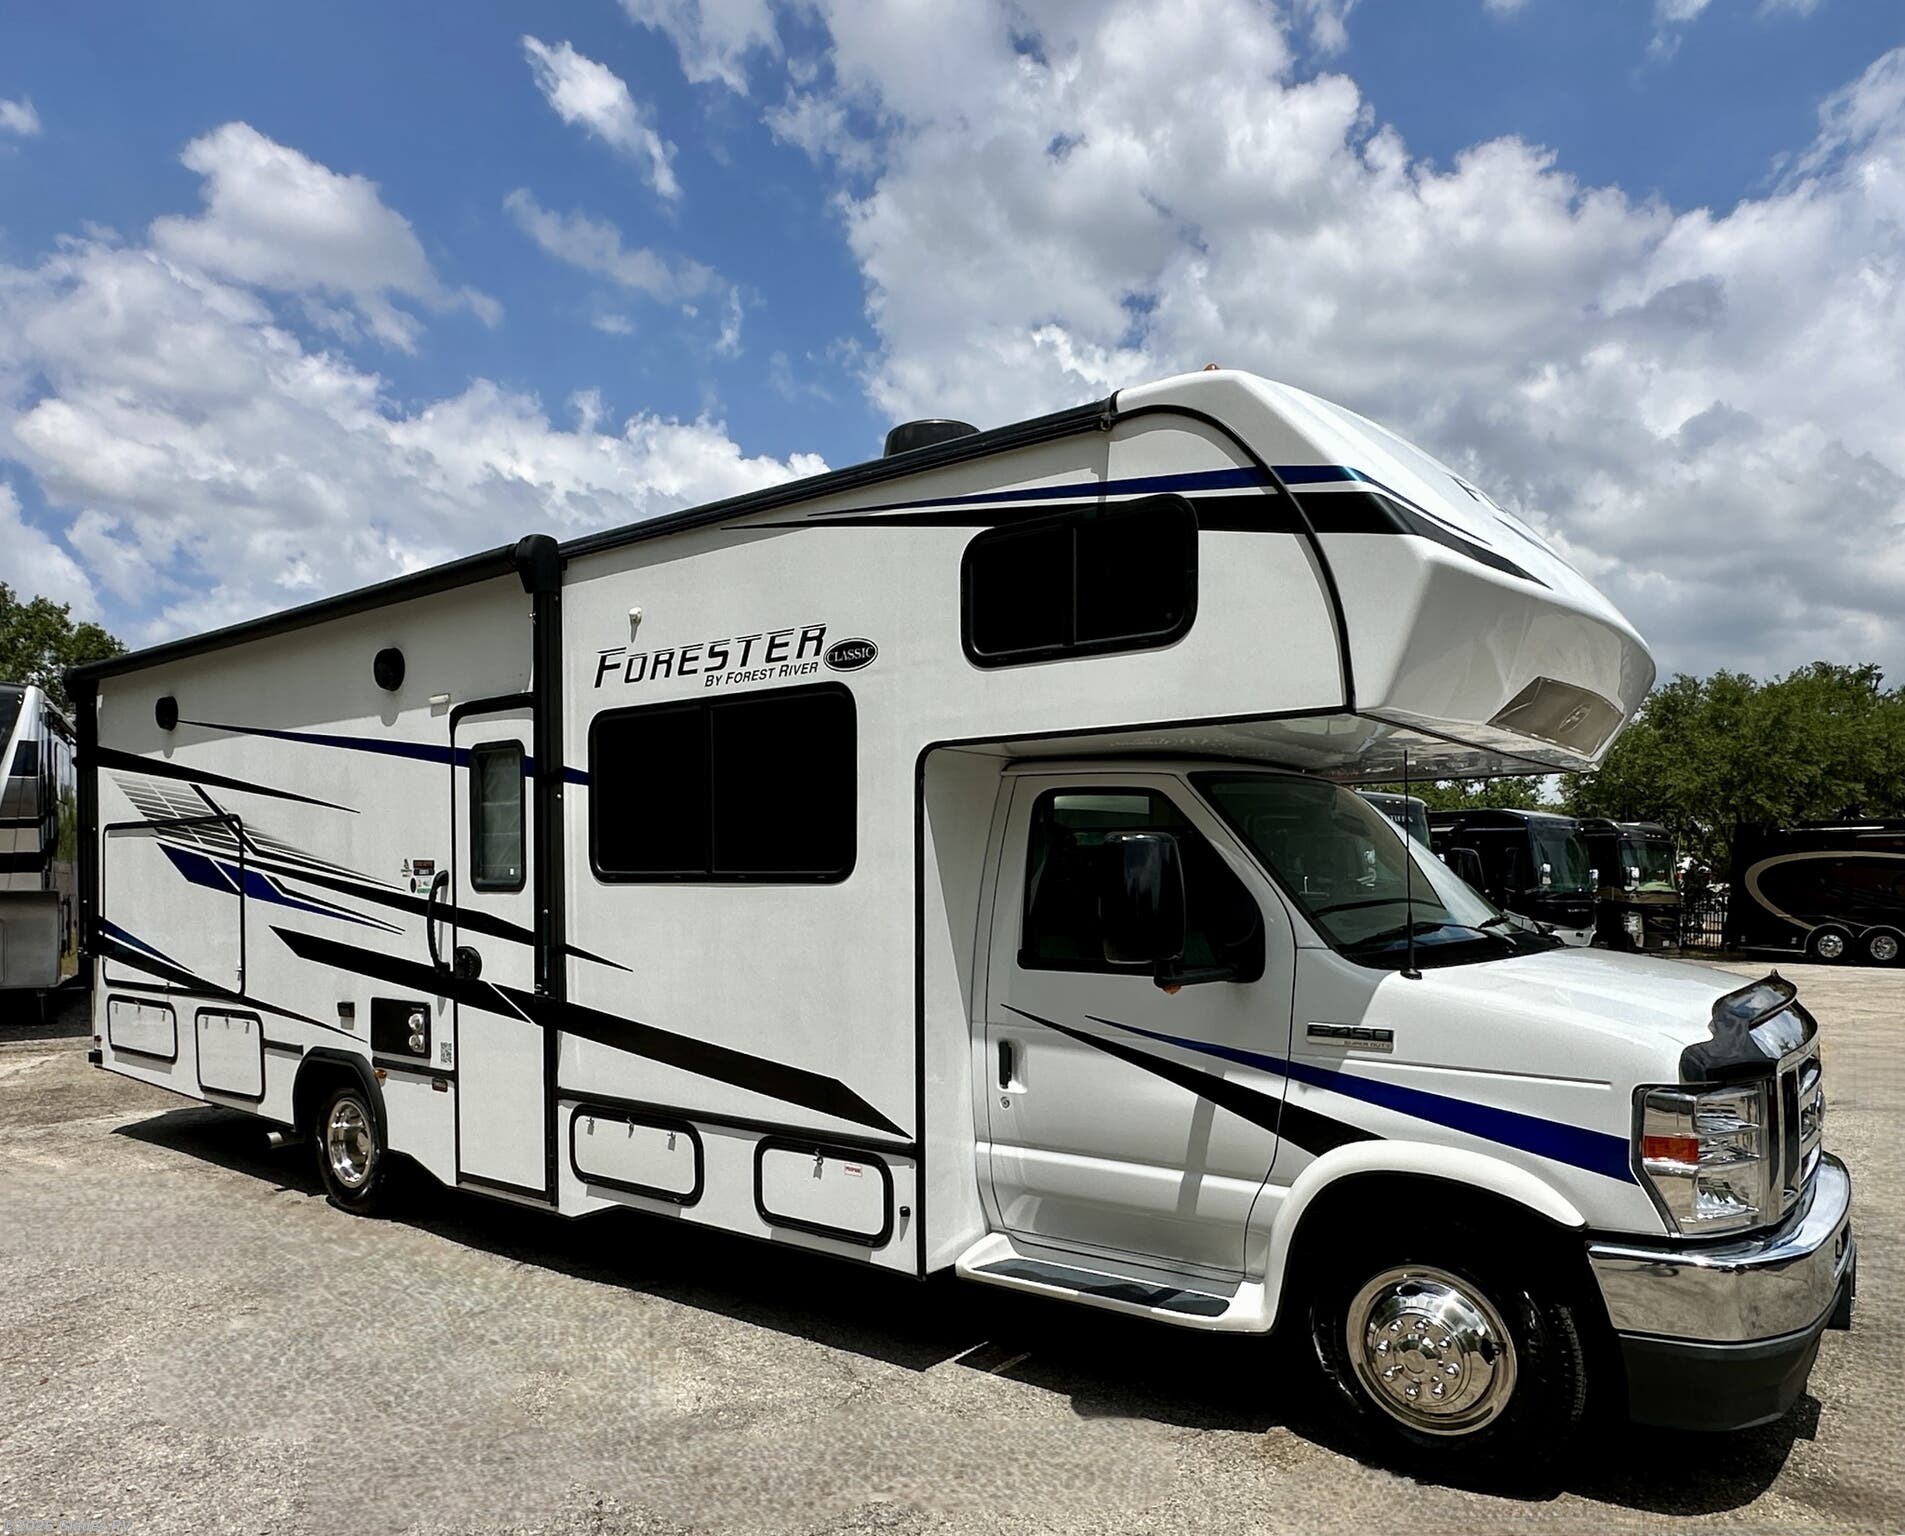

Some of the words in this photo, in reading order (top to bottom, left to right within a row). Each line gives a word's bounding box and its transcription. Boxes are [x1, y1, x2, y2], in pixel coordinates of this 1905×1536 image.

[594, 623, 827, 688] FORESTER
[826, 646, 874, 664] CLASSIC
[704, 675, 722, 687] BY
[725, 669, 775, 685] FOREST
[778, 662, 819, 678] RIVER
